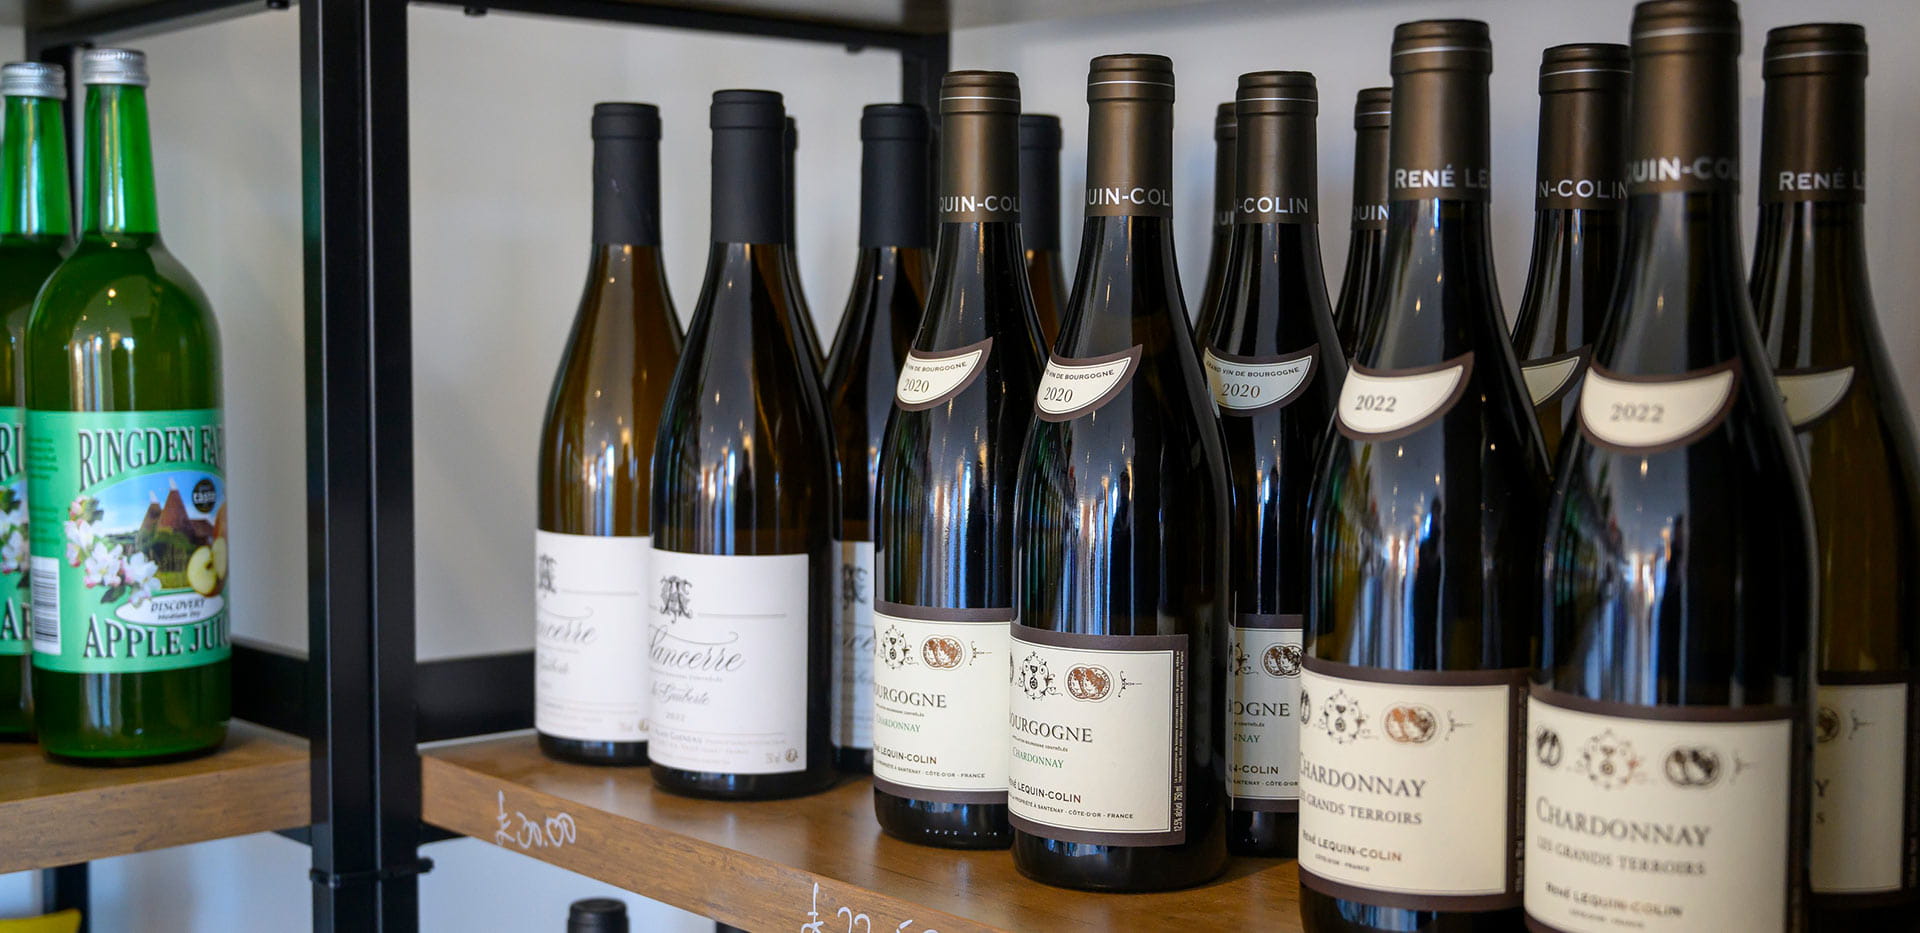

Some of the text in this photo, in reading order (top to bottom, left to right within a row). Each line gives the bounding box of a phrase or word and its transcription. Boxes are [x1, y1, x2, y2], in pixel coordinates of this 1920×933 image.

[1395, 164, 1456, 189] RENÉ
[1779, 167, 1847, 191] RENÉ
[1235, 197, 1309, 213] -COLIN
[922, 361, 968, 373] BOURGOGNE
[1064, 369, 1115, 381] BOURGOGNE
[1222, 368, 1234, 376] VIN
[1247, 366, 1300, 377] BOURGOGNE
[903, 378, 930, 394] 2020
[1043, 386, 1073, 403] 2020
[1221, 383, 1261, 399] 2020
[1355, 394, 1397, 412] 2022
[1609, 401, 1665, 422] 2022
[78, 427, 196, 492] RINGDEN
[150, 598, 206, 612] DISCOVERY
[83, 612, 185, 658] APPLE
[881, 748, 937, 765] LEQUIN-COLIN
[1012, 746, 1064, 769] CHARDONNAY
[1017, 781, 1081, 804] LEQUIN-COLIN
[1037, 803, 1064, 814] SANTENAY
[1106, 812, 1134, 820] FRANCE
[1306, 793, 1346, 816] GRANDS
[1348, 804, 1423, 826] TERROIRS
[1536, 796, 1711, 847] CHARDONNAY
[1318, 836, 1403, 862] LEQUIN-COLIN
[1616, 853, 1706, 877] TERROIRS
